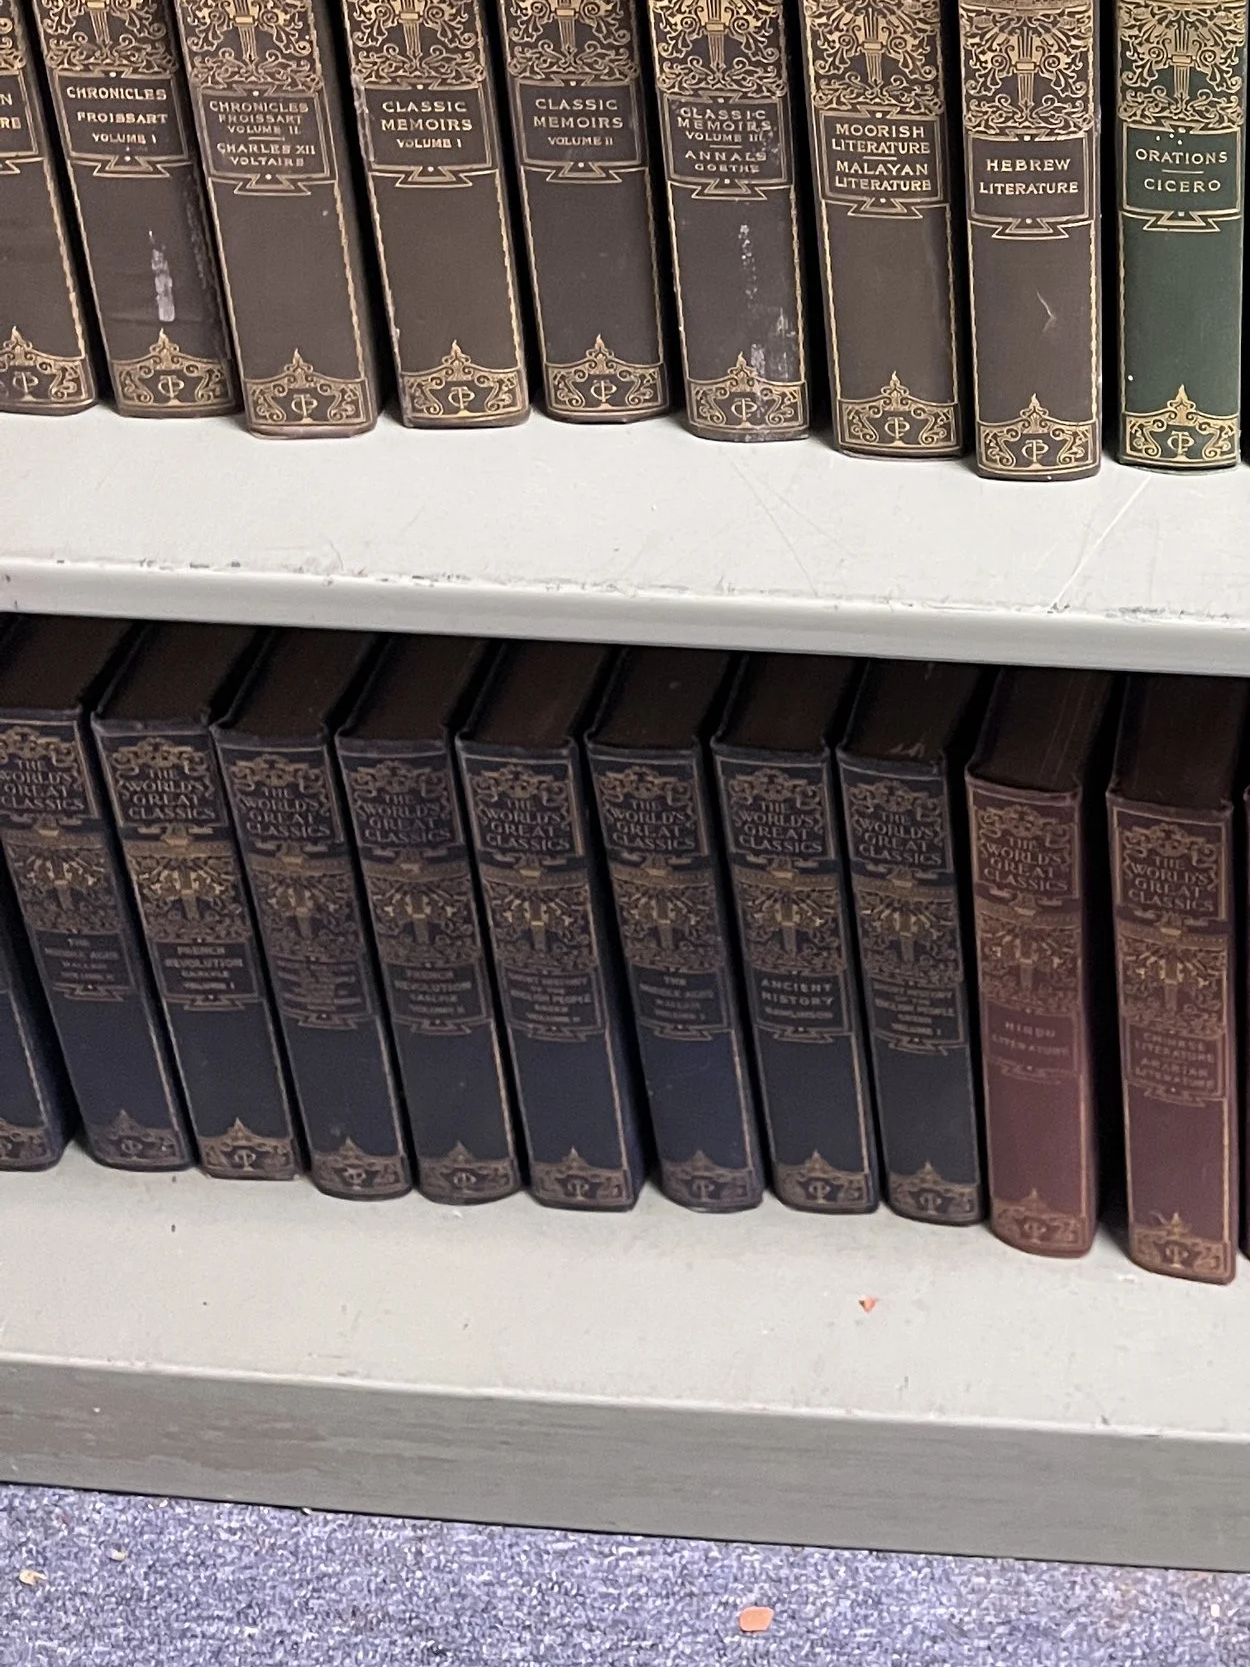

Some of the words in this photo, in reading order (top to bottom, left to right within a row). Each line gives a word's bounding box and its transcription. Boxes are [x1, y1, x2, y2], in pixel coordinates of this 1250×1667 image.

[67, 86, 167, 101] CHRONICLES
[382, 100, 466, 113] CLASSIC
[535, 98, 618, 111] CLASSIC
[77, 111, 168, 125] FROISSART
[381, 117, 473, 132] MEMOIRS
[533, 115, 624, 130] MEMOIRS
[835, 124, 924, 138] MOORISH
[92, 133, 146, 144] VOLUME
[152, 135, 157, 144] I
[397, 138, 451, 149] VOLUME
[457, 139, 462, 148] I
[547, 136, 600, 146] VOLUME
[604, 136, 613, 146] II
[832, 140, 930, 154] LITERATURE
[1135, 150, 1228, 164] ORATIONS
[836, 161, 928, 176] MALAYAN
[986, 158, 1071, 172] HEBREW
[835, 177, 932, 192] LITERATURE
[979, 181, 1078, 194] LITERATURE
[1144, 179, 1221, 192] CICERO
